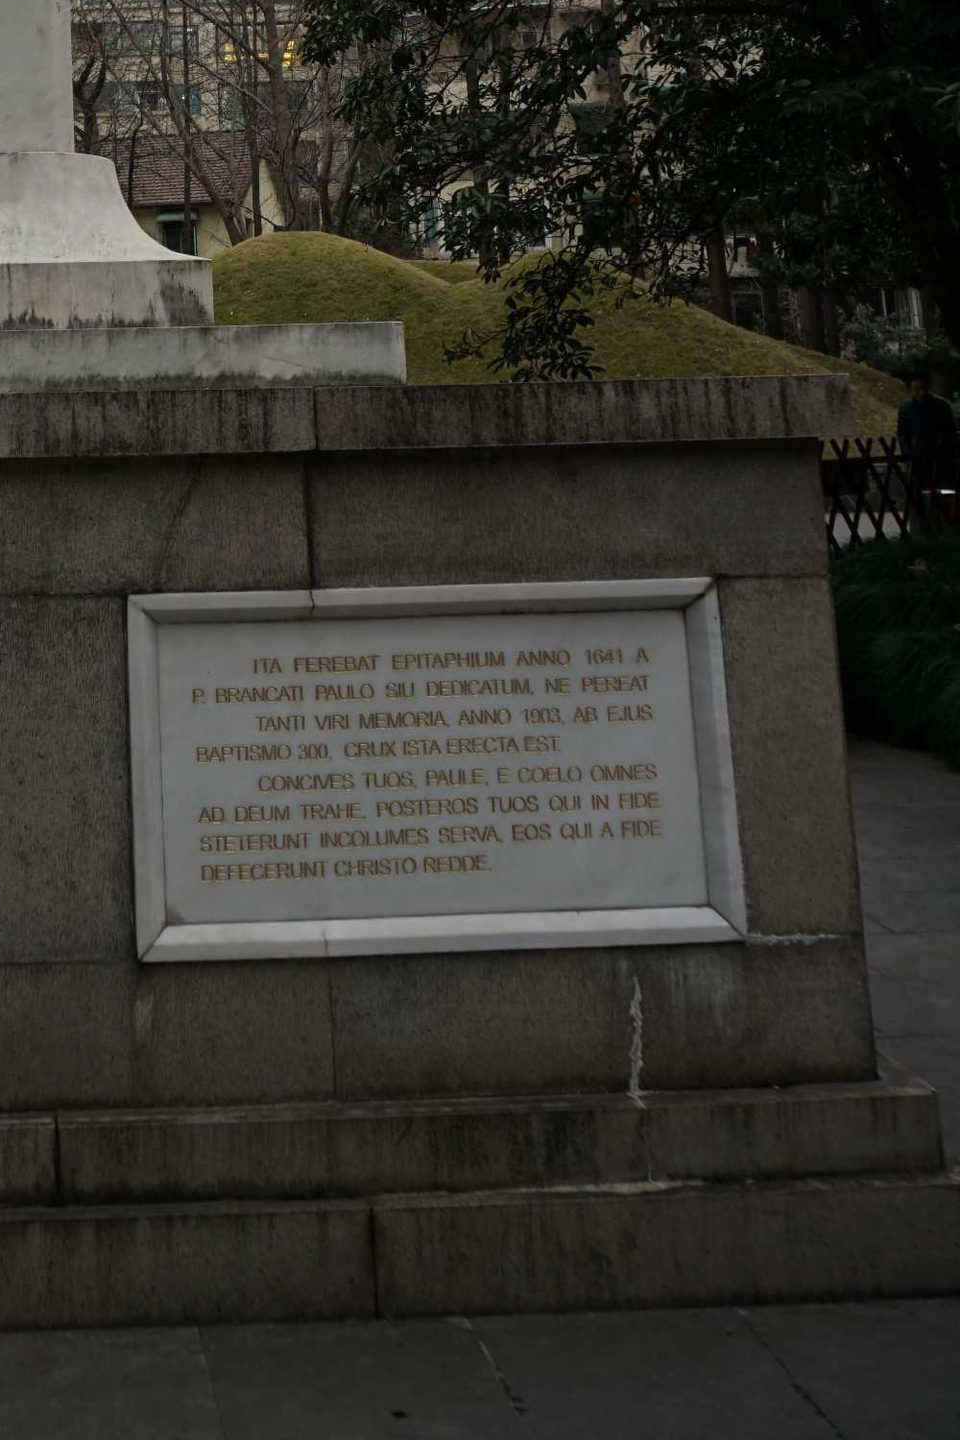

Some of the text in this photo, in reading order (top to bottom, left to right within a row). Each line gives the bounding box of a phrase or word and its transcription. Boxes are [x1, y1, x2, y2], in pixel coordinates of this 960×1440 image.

[253, 648, 650, 674] ITA FEREBAT EPITAPHIUM ANNO 1641 A
[216, 686, 303, 704] BRANCATI
[315, 684, 375, 701] PAULO
[385, 683, 415, 699] SIU
[545, 677, 571, 694] NE
[581, 675, 650, 693] PEREAT
[256, 715, 305, 732] TANTI
[315, 714, 349, 730] VIRI
[458, 708, 512, 726] ANNO
[573, 706, 599, 722] AB
[607, 704, 654, 722] EJUS
[197, 744, 292, 762] BAPTISMO
[344, 741, 397, 758] CRUX
[403, 739, 441, 756] ISTA
[447, 736, 519, 754] ERECTA
[258, 773, 354, 792] CONCIVES
[497, 768, 509, 783] E
[518, 766, 582, 784] COELO
[590, 764, 658, 782] OMNES
[199, 807, 225, 823] AD
[235, 805, 290, 823] DEUM
[376, 797, 479, 817] POSTEROS
[487, 796, 540, 813] TUOS
[549, 795, 582, 812] QUI
[592, 794, 609, 810] IN
[619, 792, 660, 809] FIDE
[200, 834, 311, 852] STETERUNT
[320, 829, 429, 848] INCOLUMES
[512, 824, 552, 841] EOS
[560, 823, 593, 840] QUI
[600, 822, 614, 838] A
[621, 820, 662, 837] FIDE
[201, 862, 327, 882] DEFECERUNT
[334, 857, 417, 876] CHRISTO
